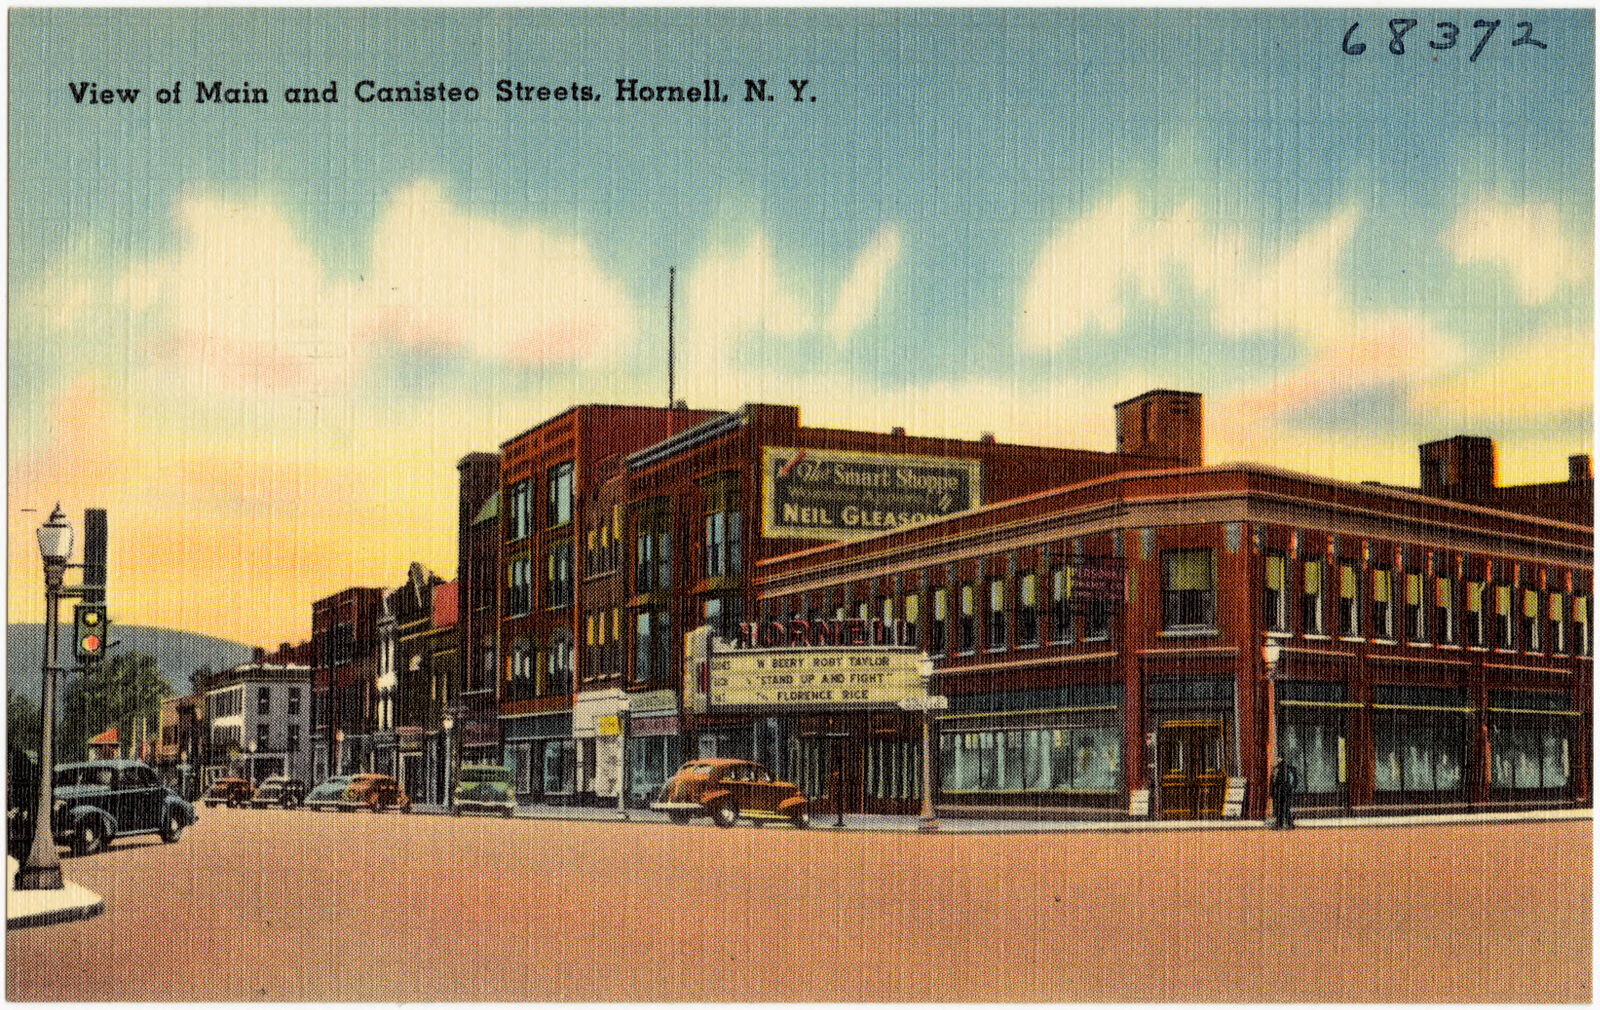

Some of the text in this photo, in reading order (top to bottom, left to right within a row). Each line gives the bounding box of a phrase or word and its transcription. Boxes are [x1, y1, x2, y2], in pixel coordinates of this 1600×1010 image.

[1341, 18, 1548, 62] 68372
[797, 460, 960, 495] The Smart Shoppe
[783, 502, 833, 525] NEIL
[738, 616, 914, 648] HORNELL
[772, 656, 805, 669] BEERY
[848, 655, 890, 668] TAYLOR
[800, 673, 816, 685] UP
[821, 672, 846, 684] AND
[777, 690, 833, 702] FLORENCE
[842, 689, 870, 700] RICE
